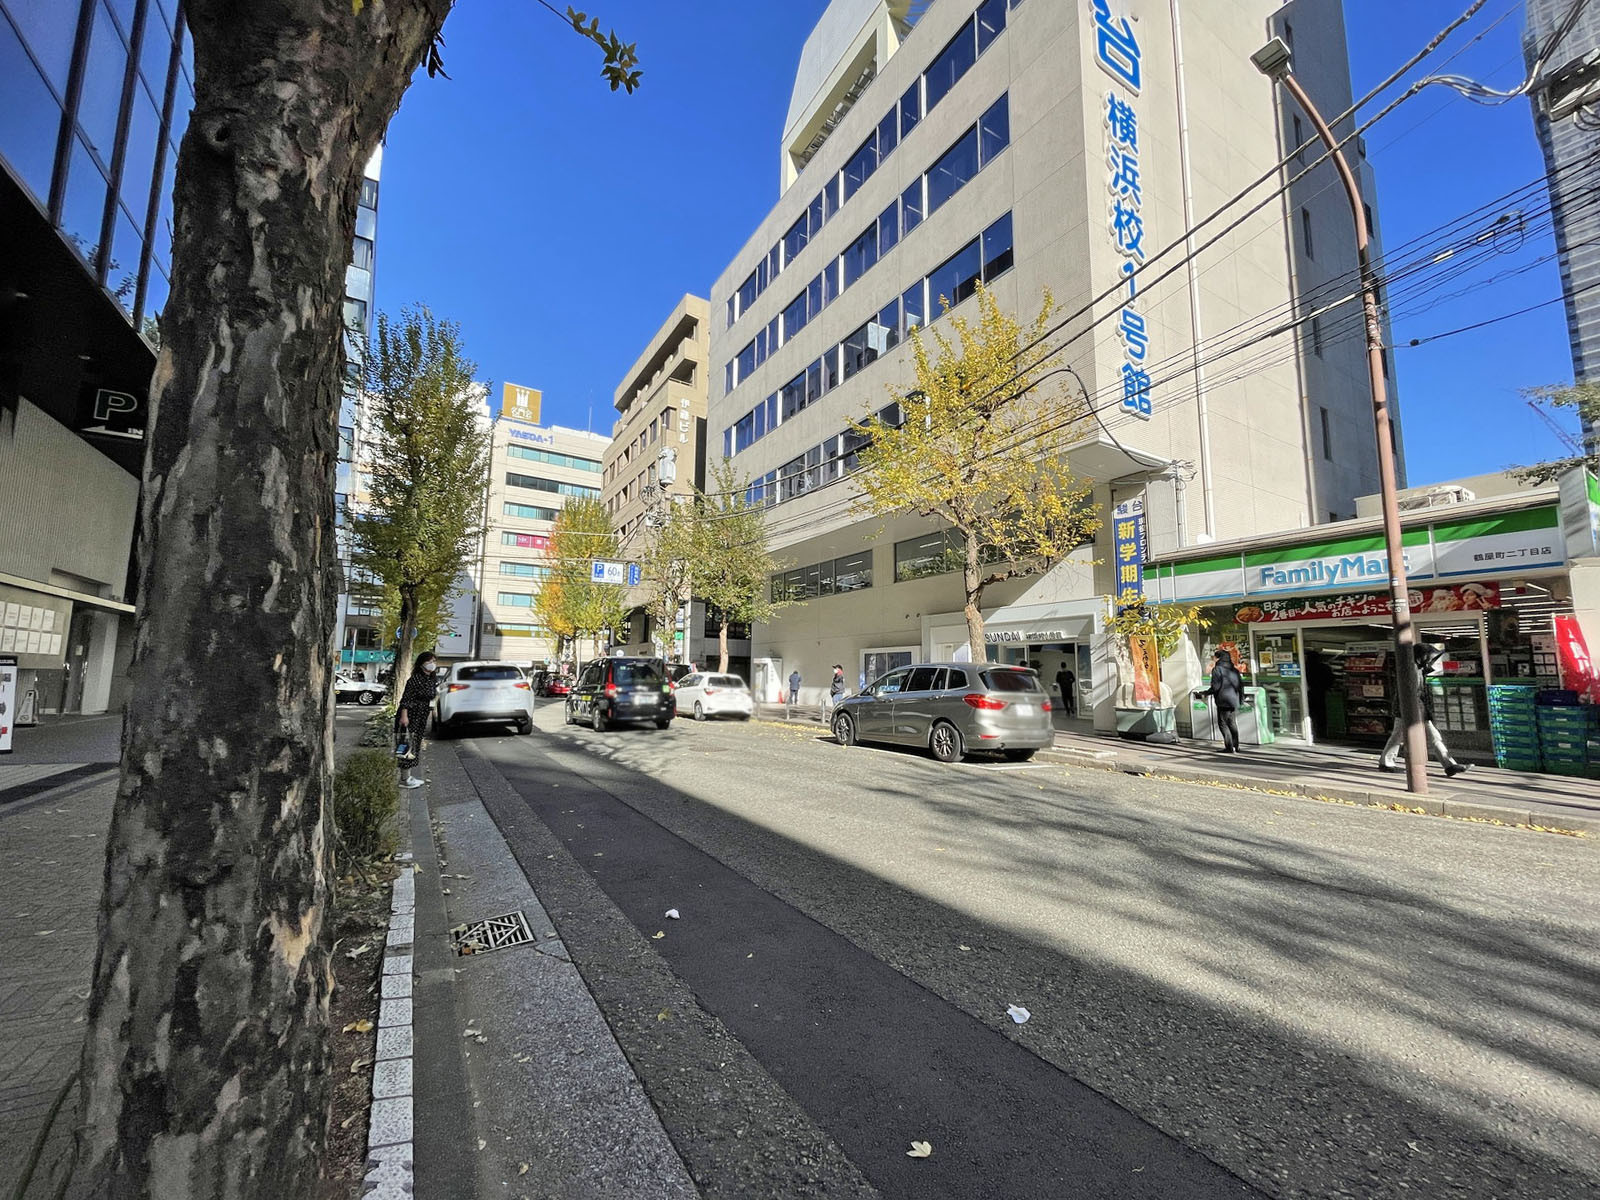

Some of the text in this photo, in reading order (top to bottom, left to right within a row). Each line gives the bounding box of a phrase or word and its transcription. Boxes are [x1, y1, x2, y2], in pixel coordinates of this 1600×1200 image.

[93, 388, 137, 420] P
[1473, 546, 1552, 562] 鶴屋町二丁目店
